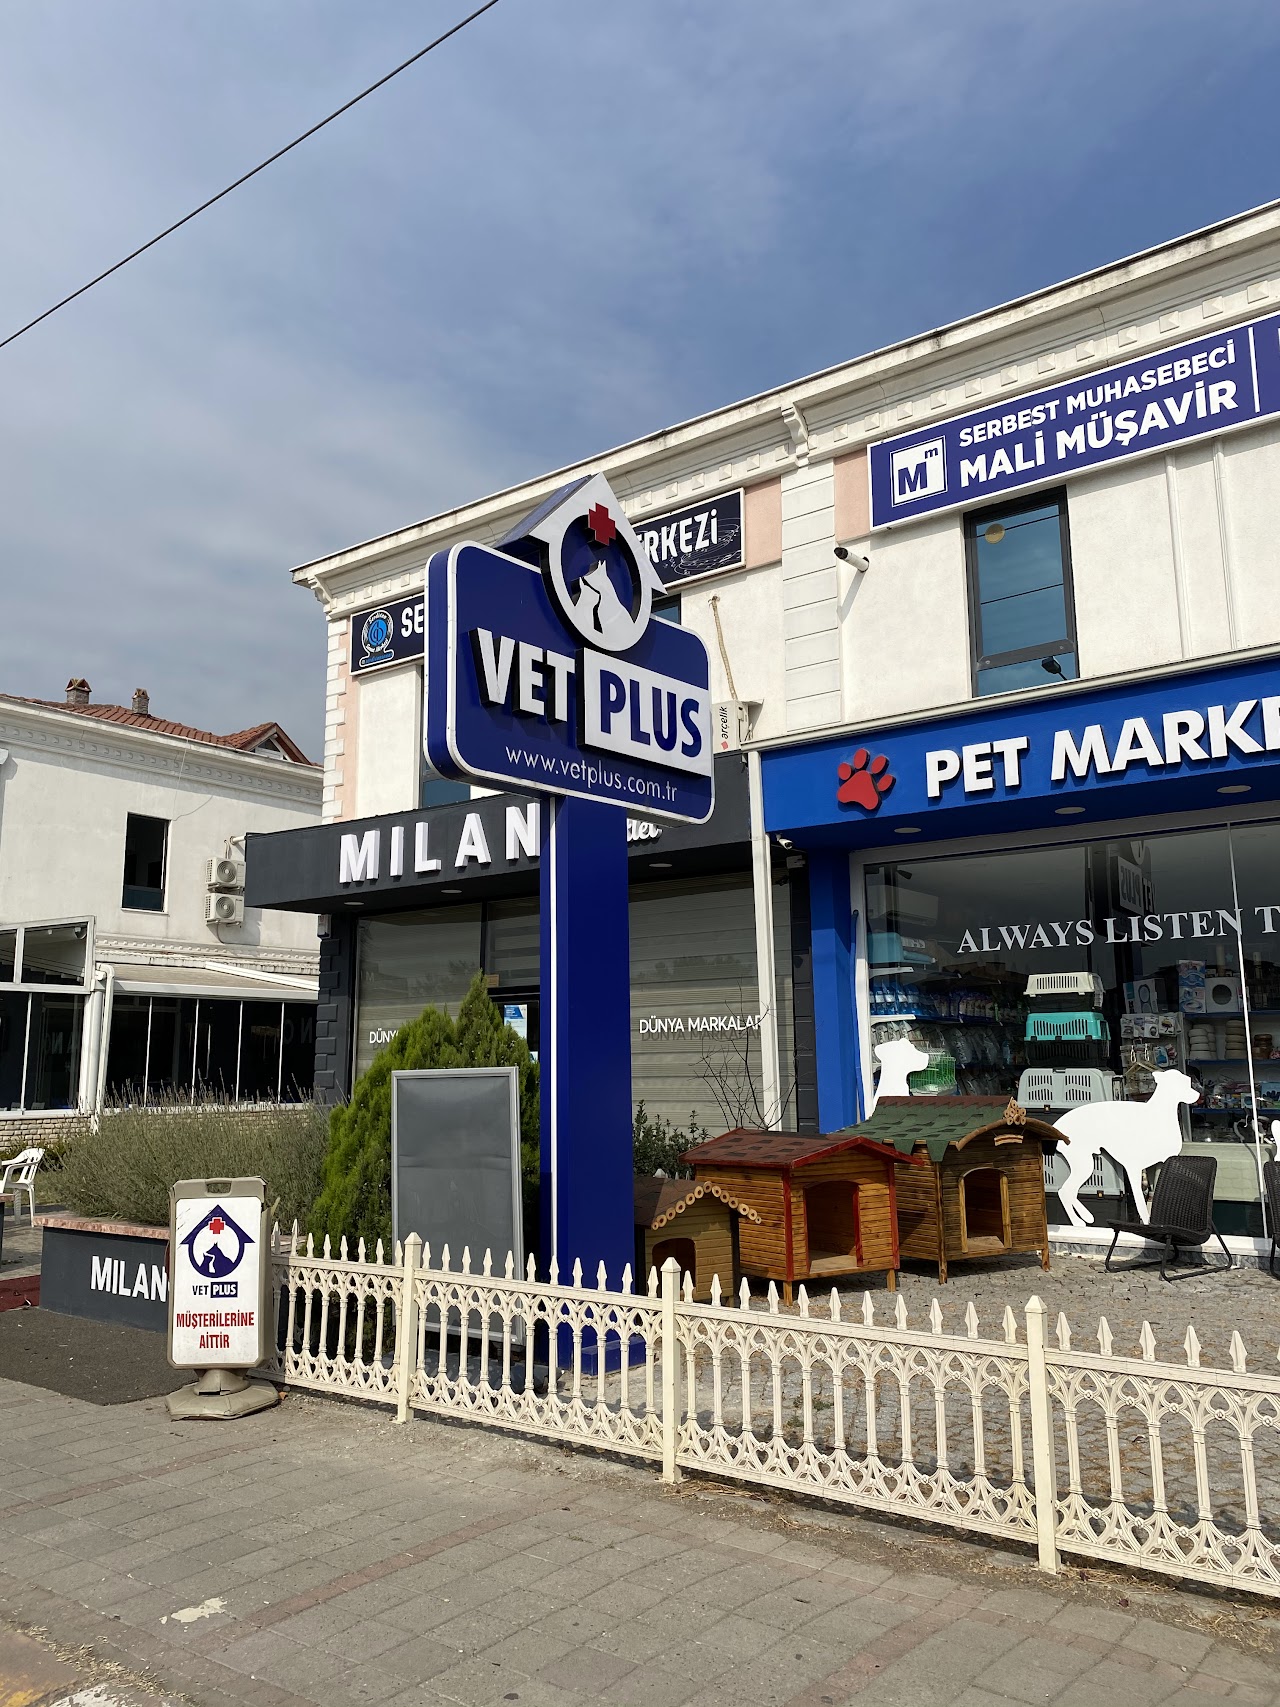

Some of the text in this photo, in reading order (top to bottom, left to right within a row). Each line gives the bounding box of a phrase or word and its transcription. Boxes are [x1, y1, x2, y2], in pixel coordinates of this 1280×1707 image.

[959, 400, 1060, 448] SERBEST
[1067, 339, 1236, 415] MUHASEBECİ
[959, 380, 1239, 488] MALİ MÜŞAVİR
[476, 627, 702, 759] VET PLUS
[506, 746, 678, 801] www.vetplus.com.tr
[926, 736, 1030, 798] PET
[956, 919, 1095, 954] ALWAYS
[1104, 908, 1243, 945] LISTEN
[369, 1028, 399, 1044] DÜNY
[640, 1015, 685, 1034] DÜNYA
[192, 1284, 237, 1296] VET PLUS
[176, 1309, 255, 1329] MÜŞTERİLERİNE
[199, 1331, 230, 1349] AİTTİR
